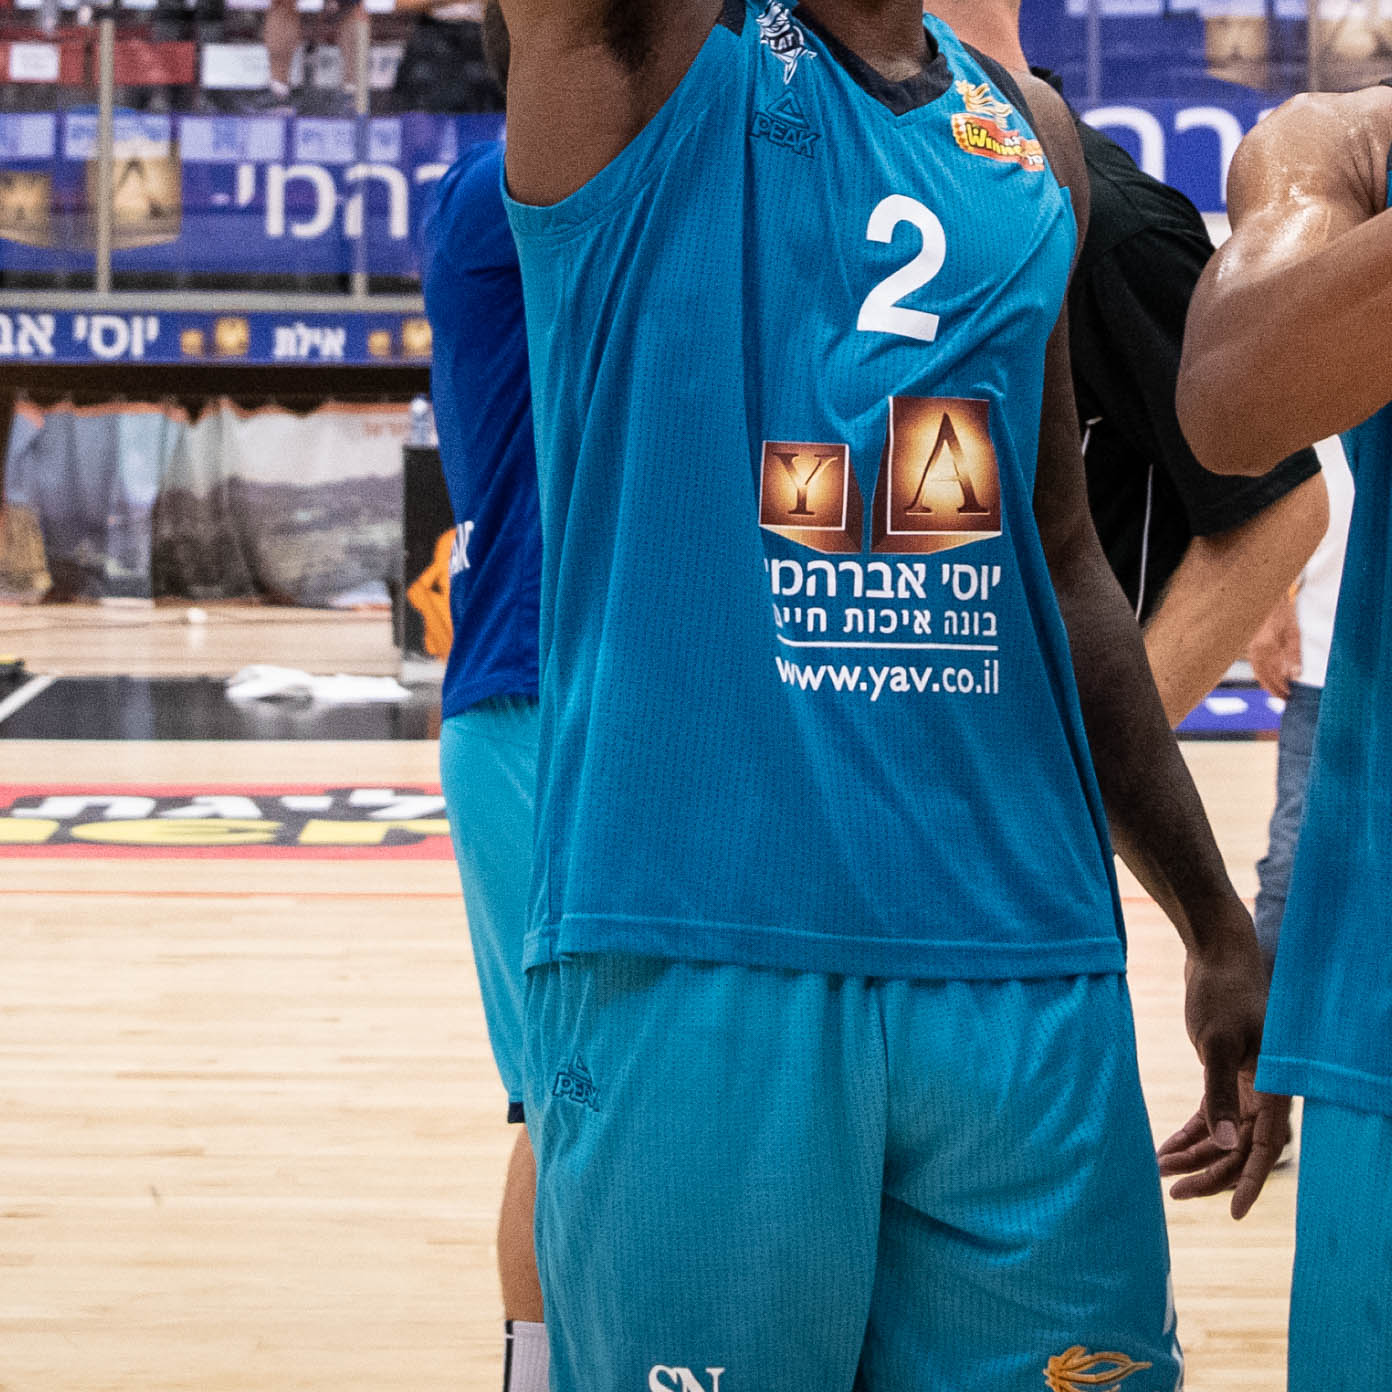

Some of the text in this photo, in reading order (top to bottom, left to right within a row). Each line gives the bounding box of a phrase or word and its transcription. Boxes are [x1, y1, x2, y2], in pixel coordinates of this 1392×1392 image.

[751, 111, 823, 159] PEAK
[857, 194, 947, 342] 2
[74, 315, 159, 360] יוסי
[273, 321, 345, 359] אילת
[763, 557, 1002, 601] יוסי אברהמי
[843, 607, 932, 635] איכות
[944, 611, 998, 637] בונה
[775, 656, 1000, 702] www.yav.co.il
